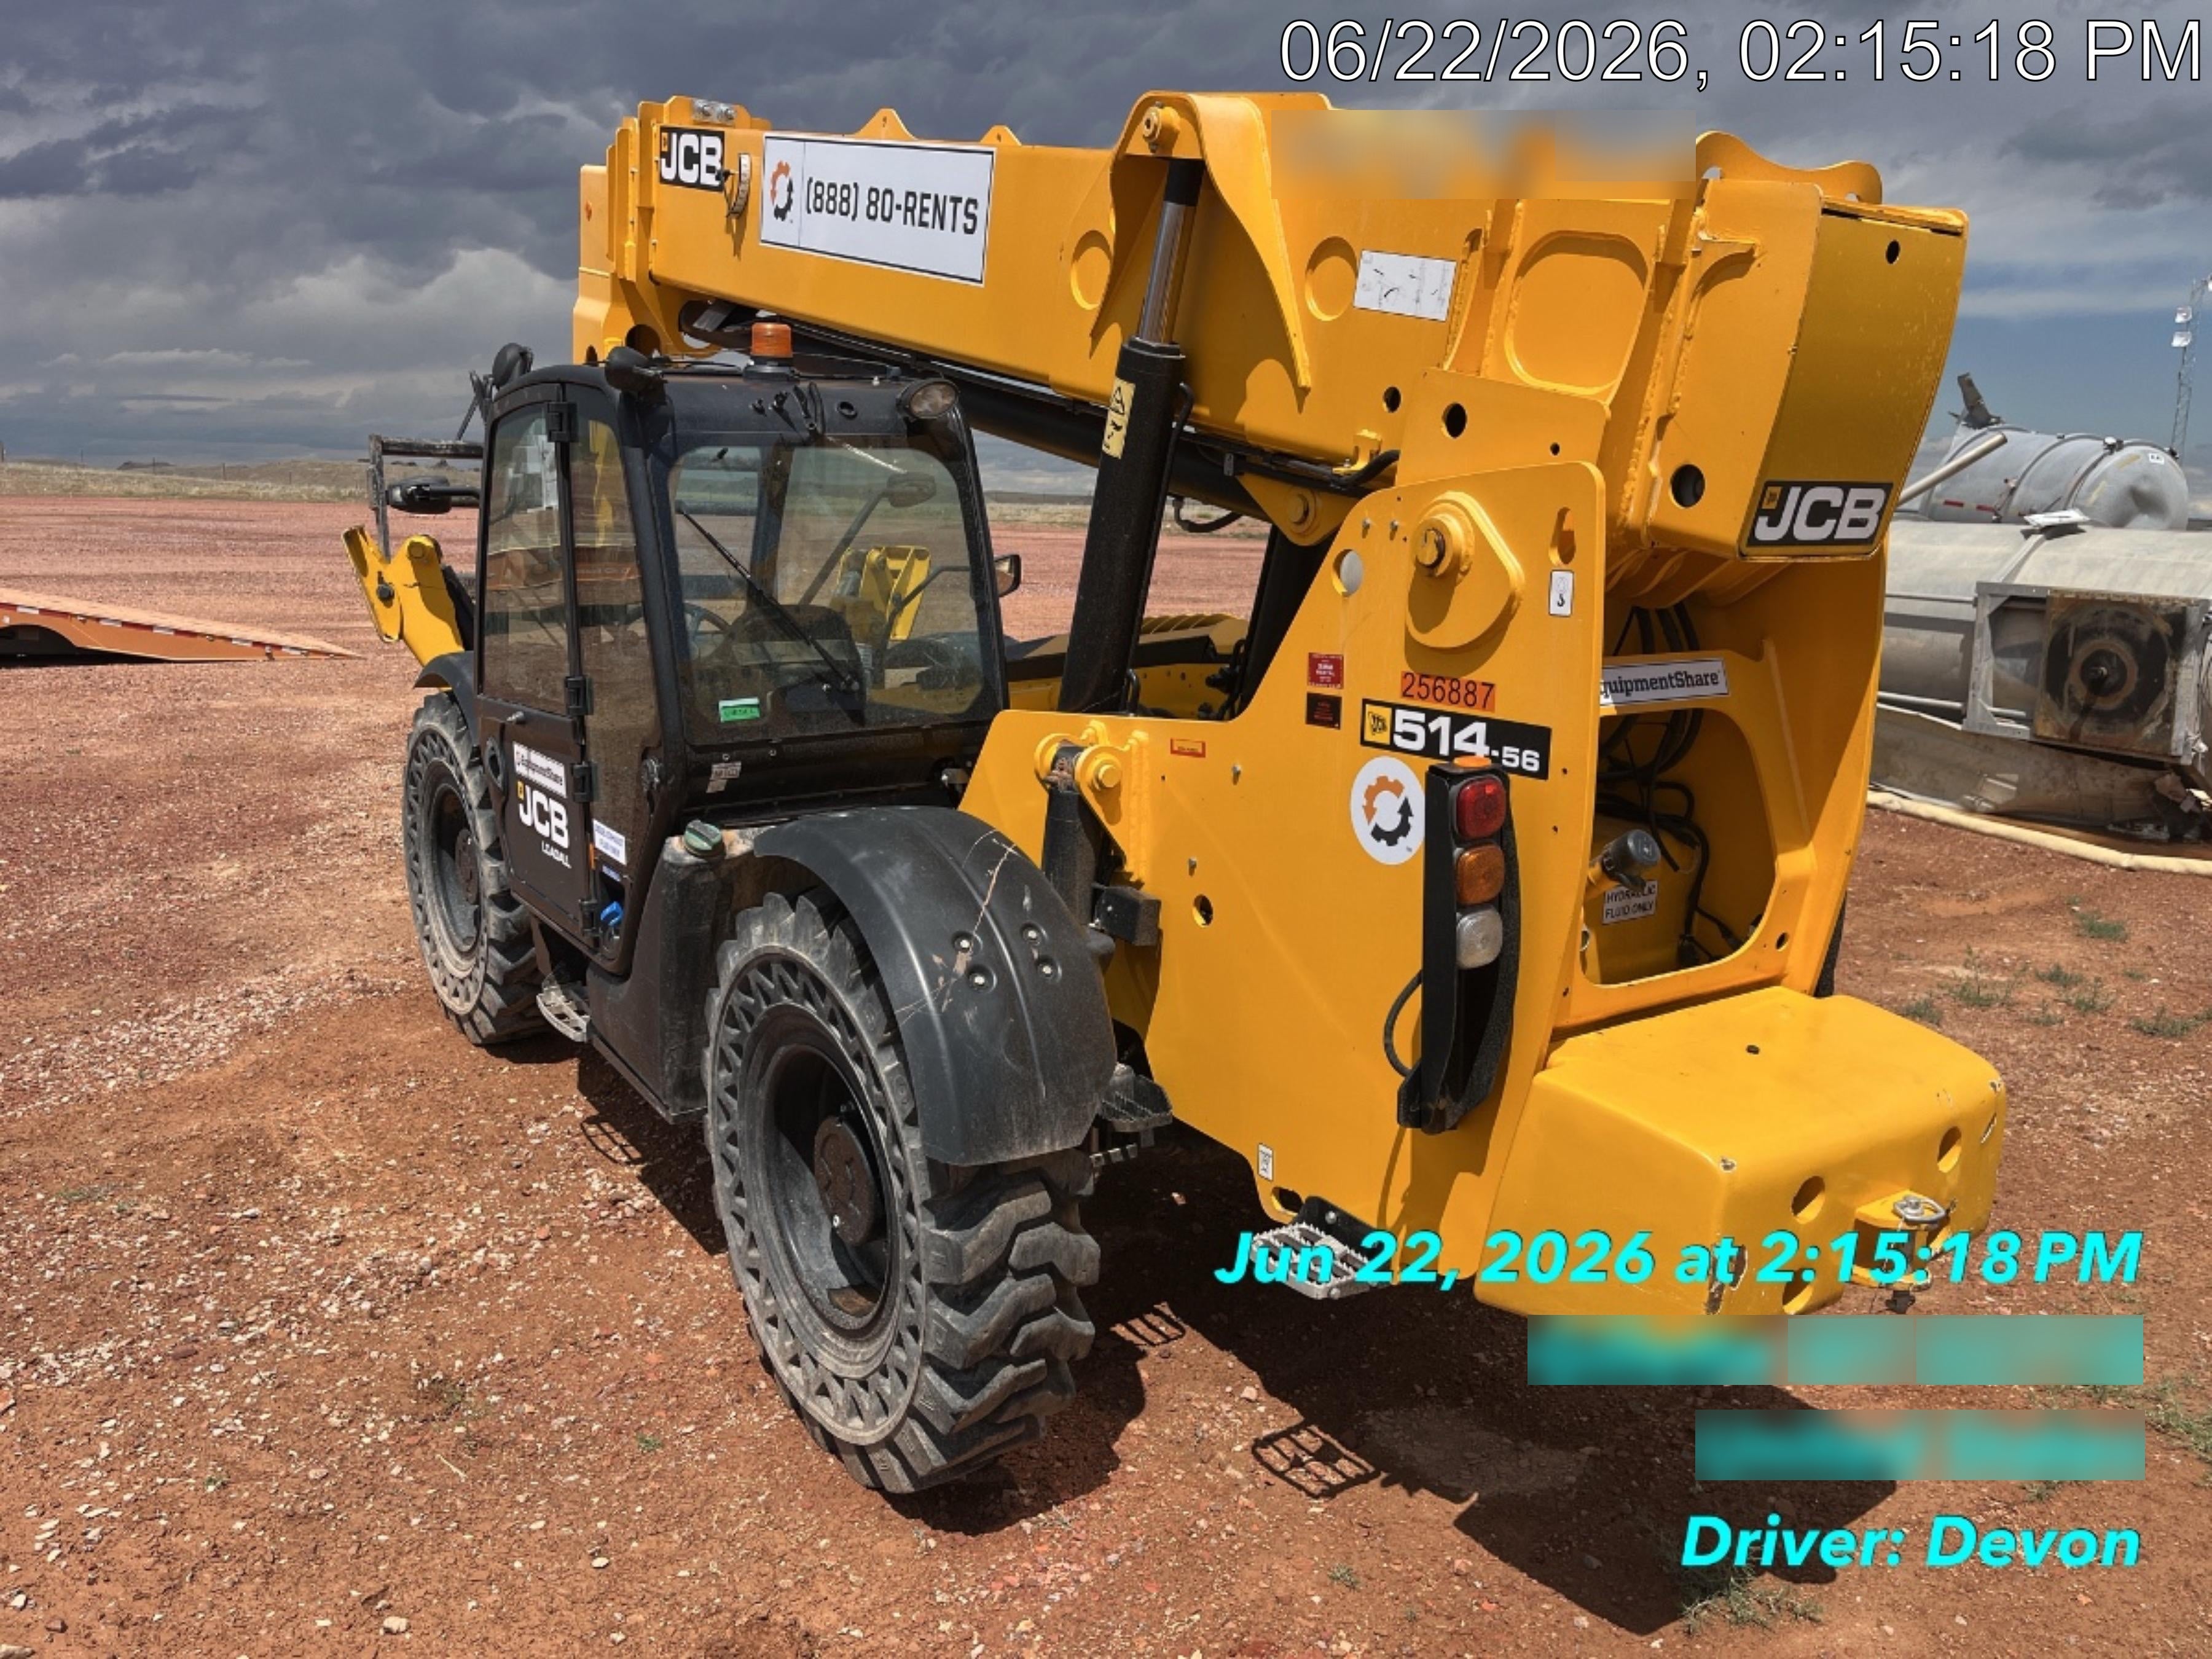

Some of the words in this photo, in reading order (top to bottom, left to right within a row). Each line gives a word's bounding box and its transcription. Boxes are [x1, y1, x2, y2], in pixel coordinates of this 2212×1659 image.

[660, 132, 722, 186] JCB
[806, 178, 859, 221] (888)
[866, 187, 978, 235] 80-RENTS
[1754, 486, 1886, 541] JCB
[1402, 672, 1496, 709] 256887
[1600, 670, 1720, 699] quipmentShare
[519, 784, 569, 849] JCB
